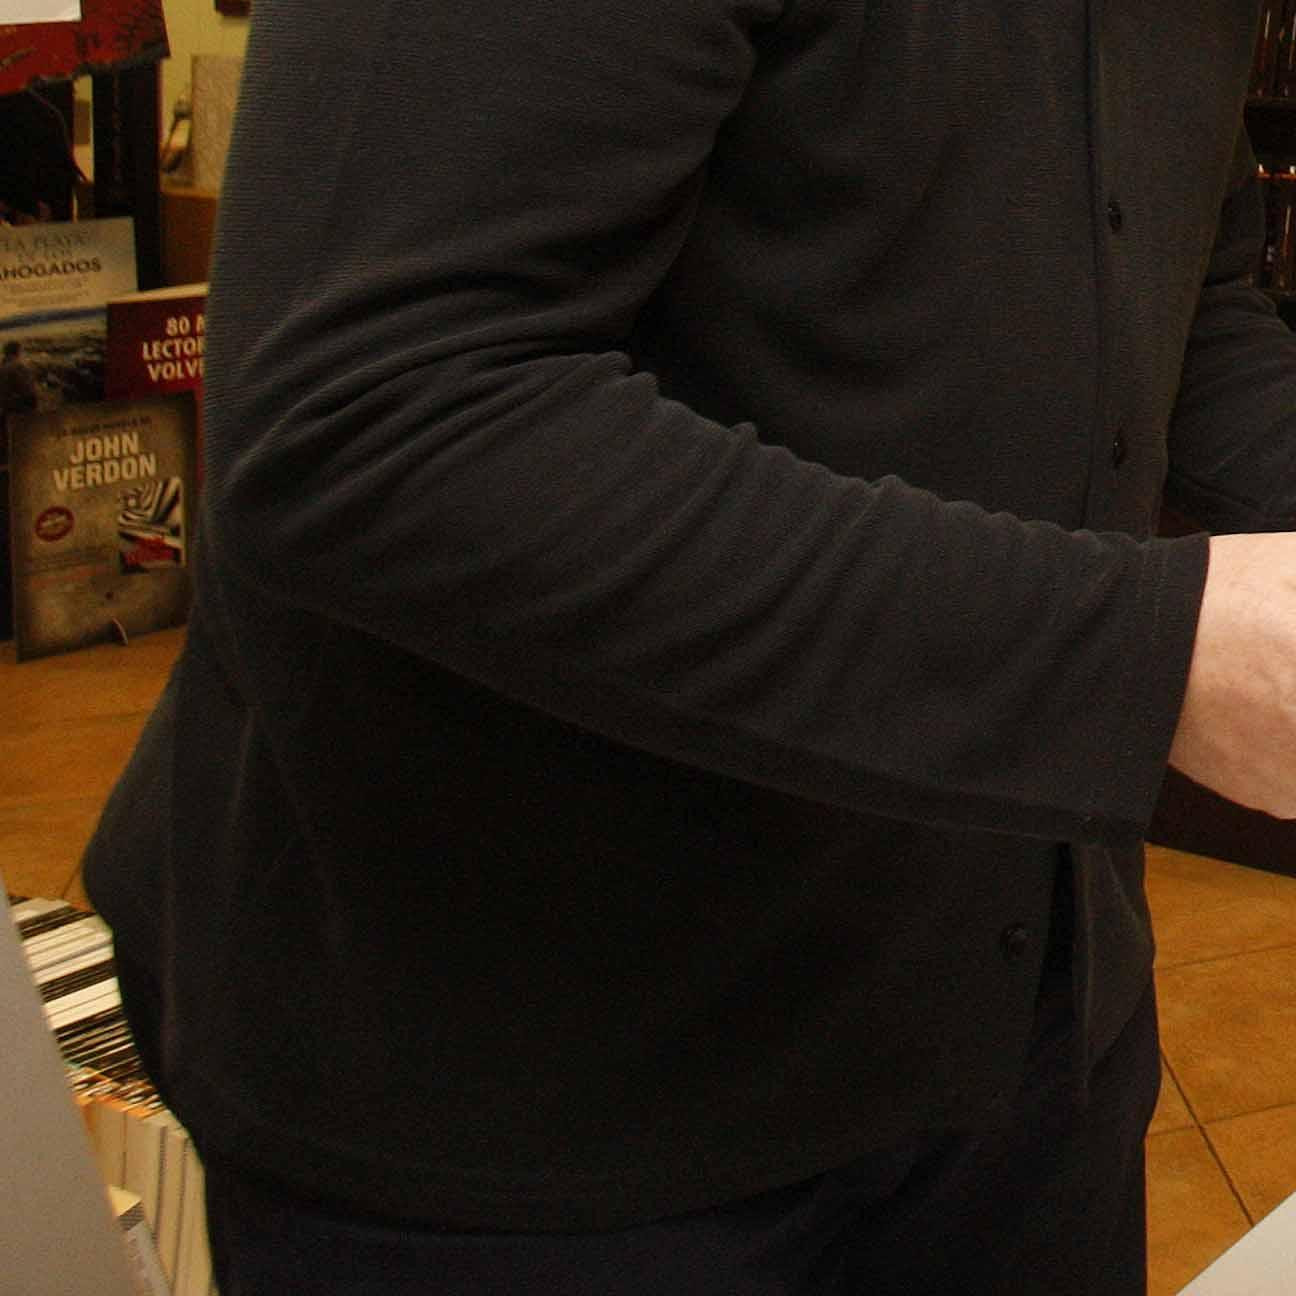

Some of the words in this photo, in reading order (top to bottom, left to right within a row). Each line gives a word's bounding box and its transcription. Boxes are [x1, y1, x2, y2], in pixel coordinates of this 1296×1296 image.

[165, 315, 191, 336] 80
[69, 431, 140, 465] JOHN
[52, 453, 158, 492] VERDON
